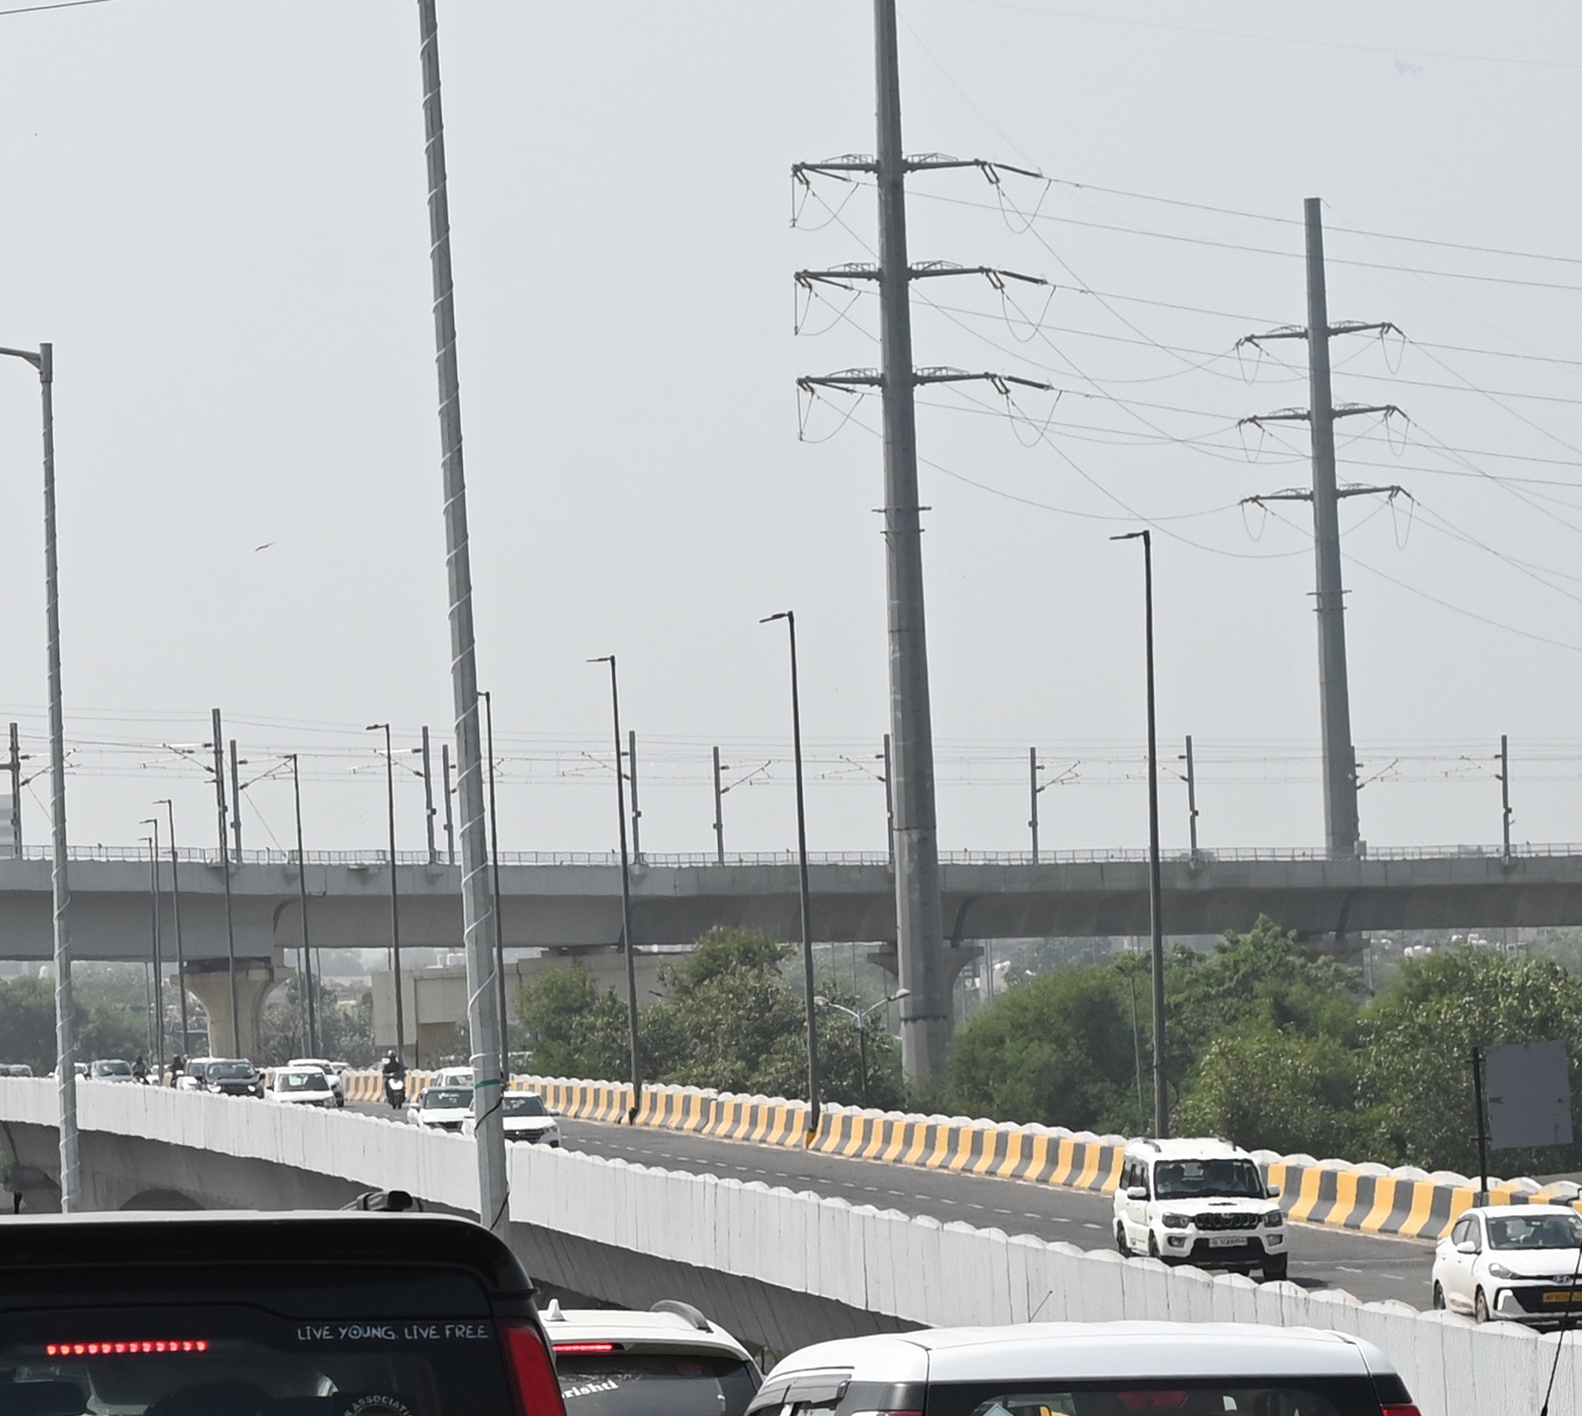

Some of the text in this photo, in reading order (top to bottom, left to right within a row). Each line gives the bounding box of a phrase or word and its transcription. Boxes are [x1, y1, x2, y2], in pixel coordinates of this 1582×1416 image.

[297, 1325, 334, 1340] LIVE
[404, 1324, 441, 1339] LIVE
[444, 1324, 489, 1339] FREE
[562, 1379, 619, 1399] rishti
